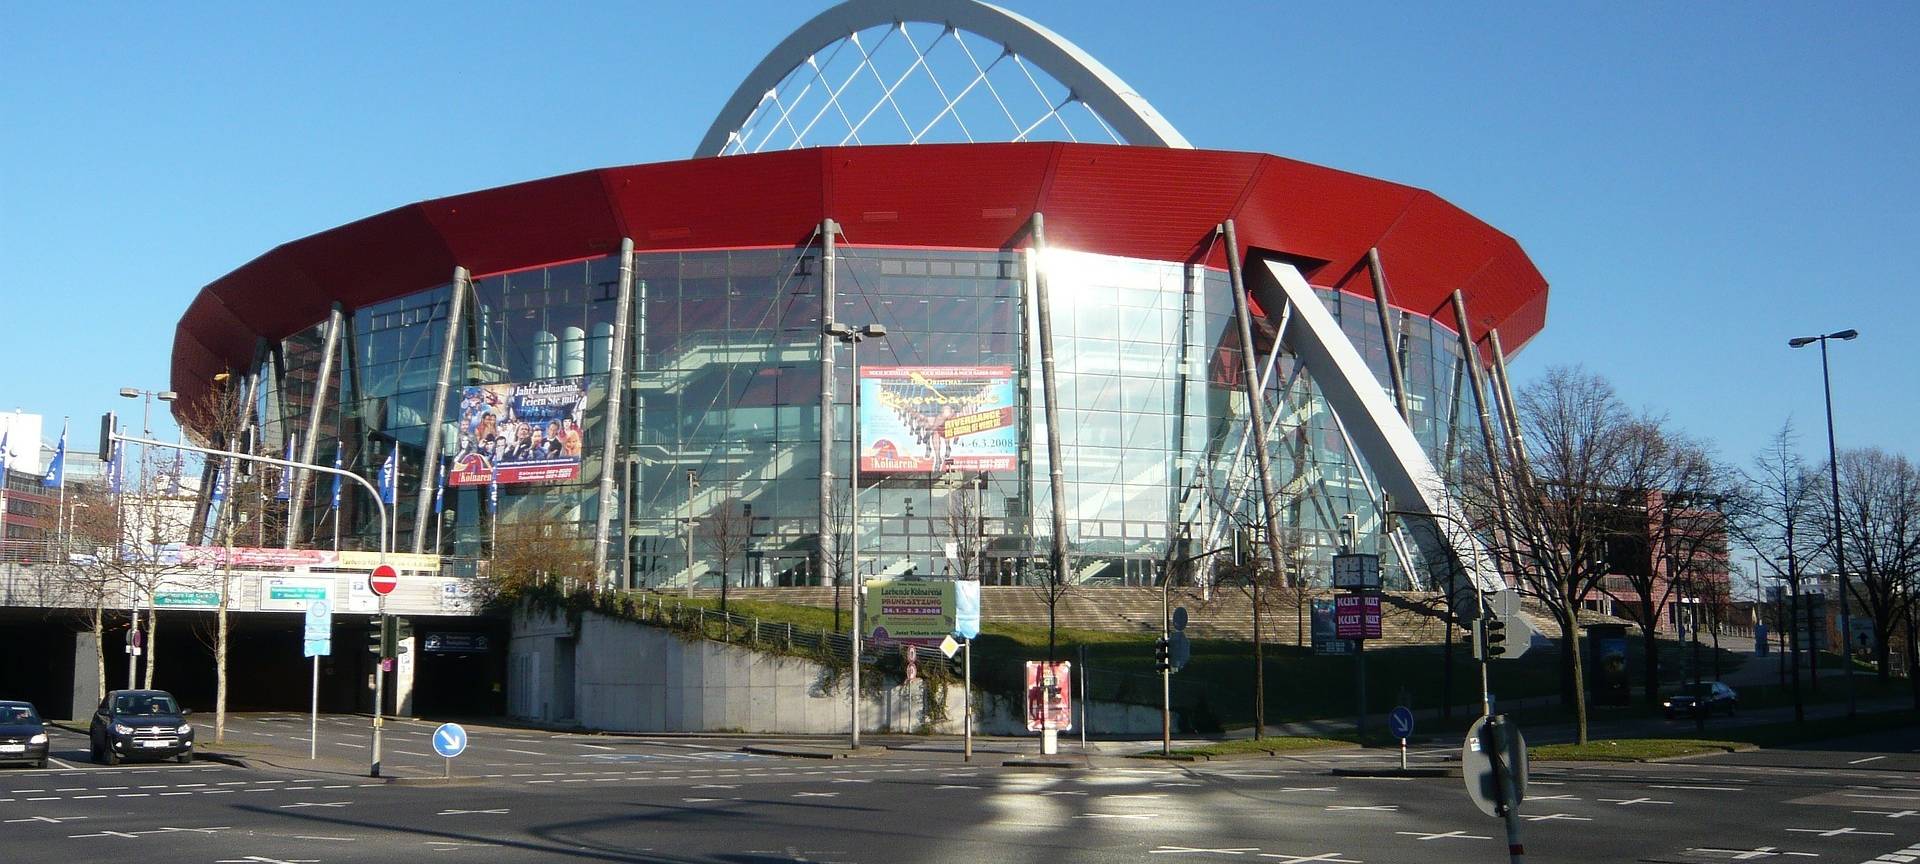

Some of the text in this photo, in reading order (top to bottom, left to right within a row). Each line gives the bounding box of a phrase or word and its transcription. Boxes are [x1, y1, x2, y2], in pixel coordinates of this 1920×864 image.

[515, 384, 537, 397] Jahre
[521, 395, 546, 407] Feiern
[547, 396, 560, 405] Sie
[944, 409, 1001, 431] RIVERDANCE
[874, 457, 918, 469] Kölnarena
[460, 471, 492, 483] Kölnaren
[1337, 597, 1360, 607] KULT
[1338, 615, 1361, 624] KULT
